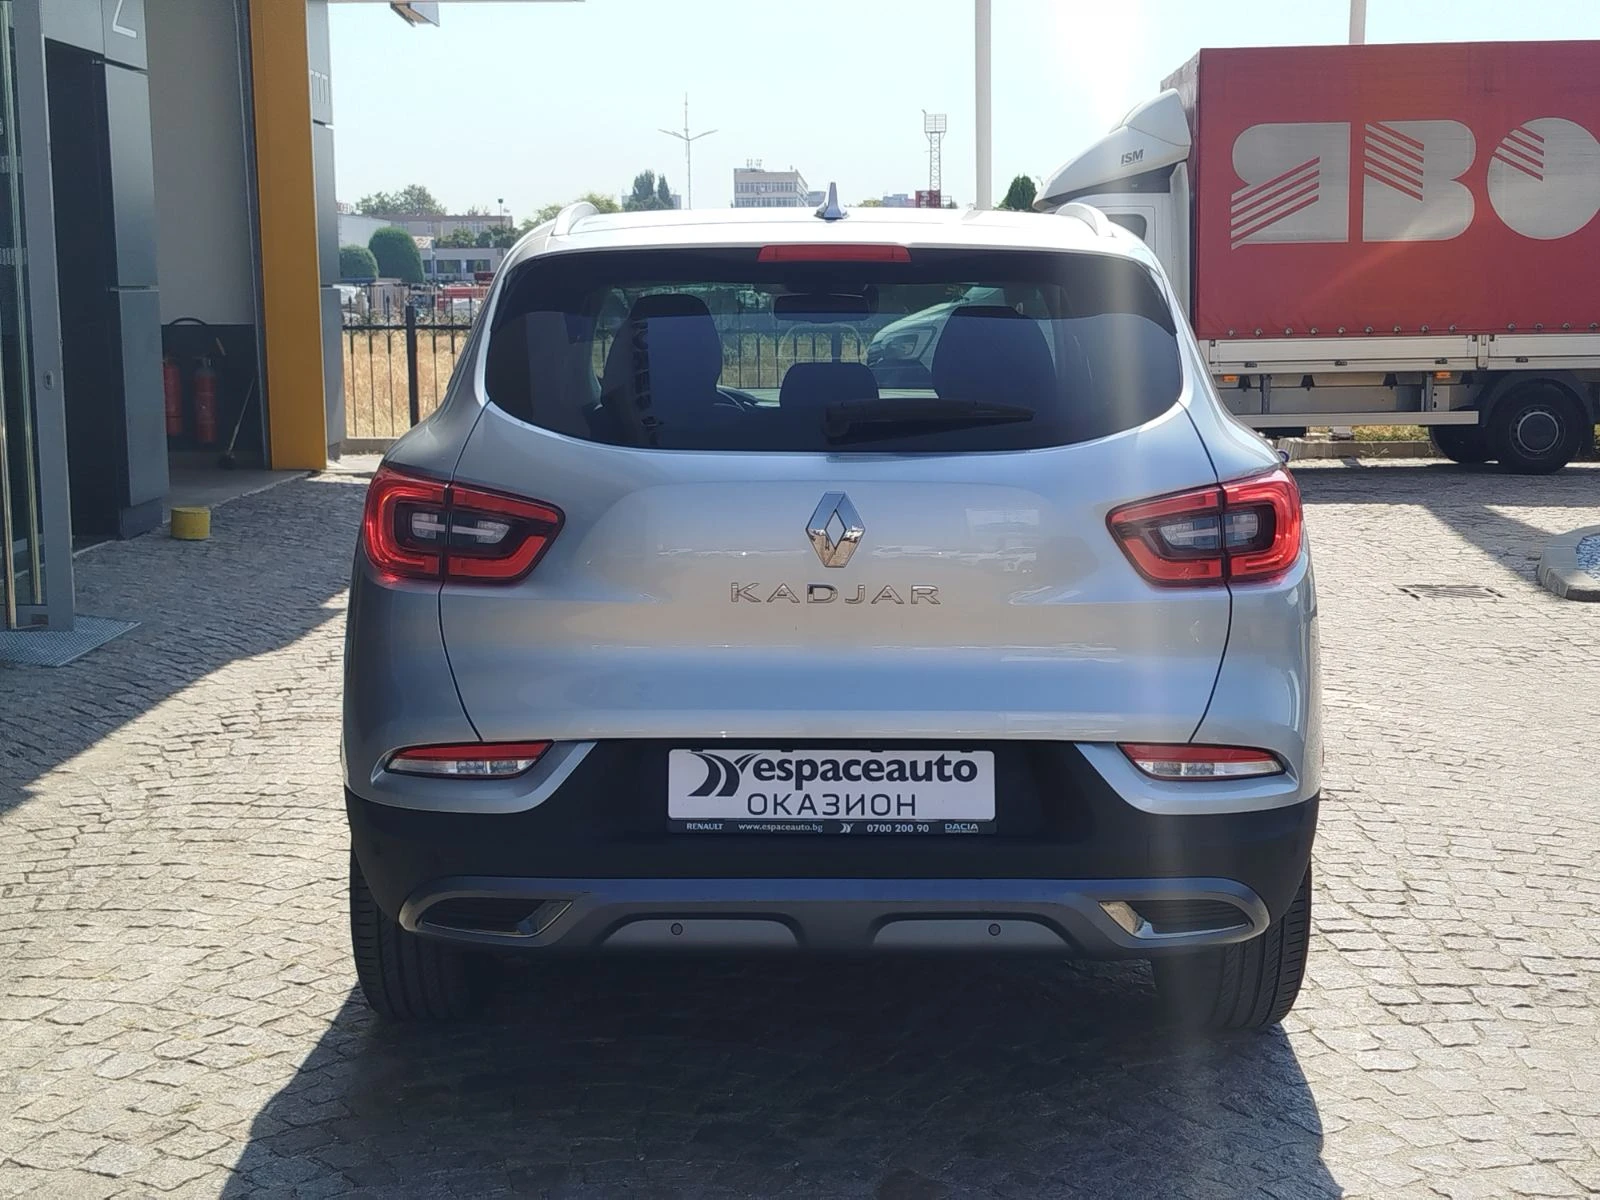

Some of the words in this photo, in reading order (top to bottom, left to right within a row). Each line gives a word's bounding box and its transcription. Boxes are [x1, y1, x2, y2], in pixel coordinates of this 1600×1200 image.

[1121, 149, 1144, 165] ISM
[731, 582, 941, 605] KADJAR
[752, 753, 978, 791] espaceauto
[747, 793, 916, 816] ОКАЗИОН
[686, 822, 724, 830] RENAULT
[738, 823, 823, 832] www.espaceauto.bg
[866, 824, 892, 833] 0700
[895, 824, 913, 833] 200
[916, 824, 930, 833] 90
[944, 823, 979, 831] DACIA
